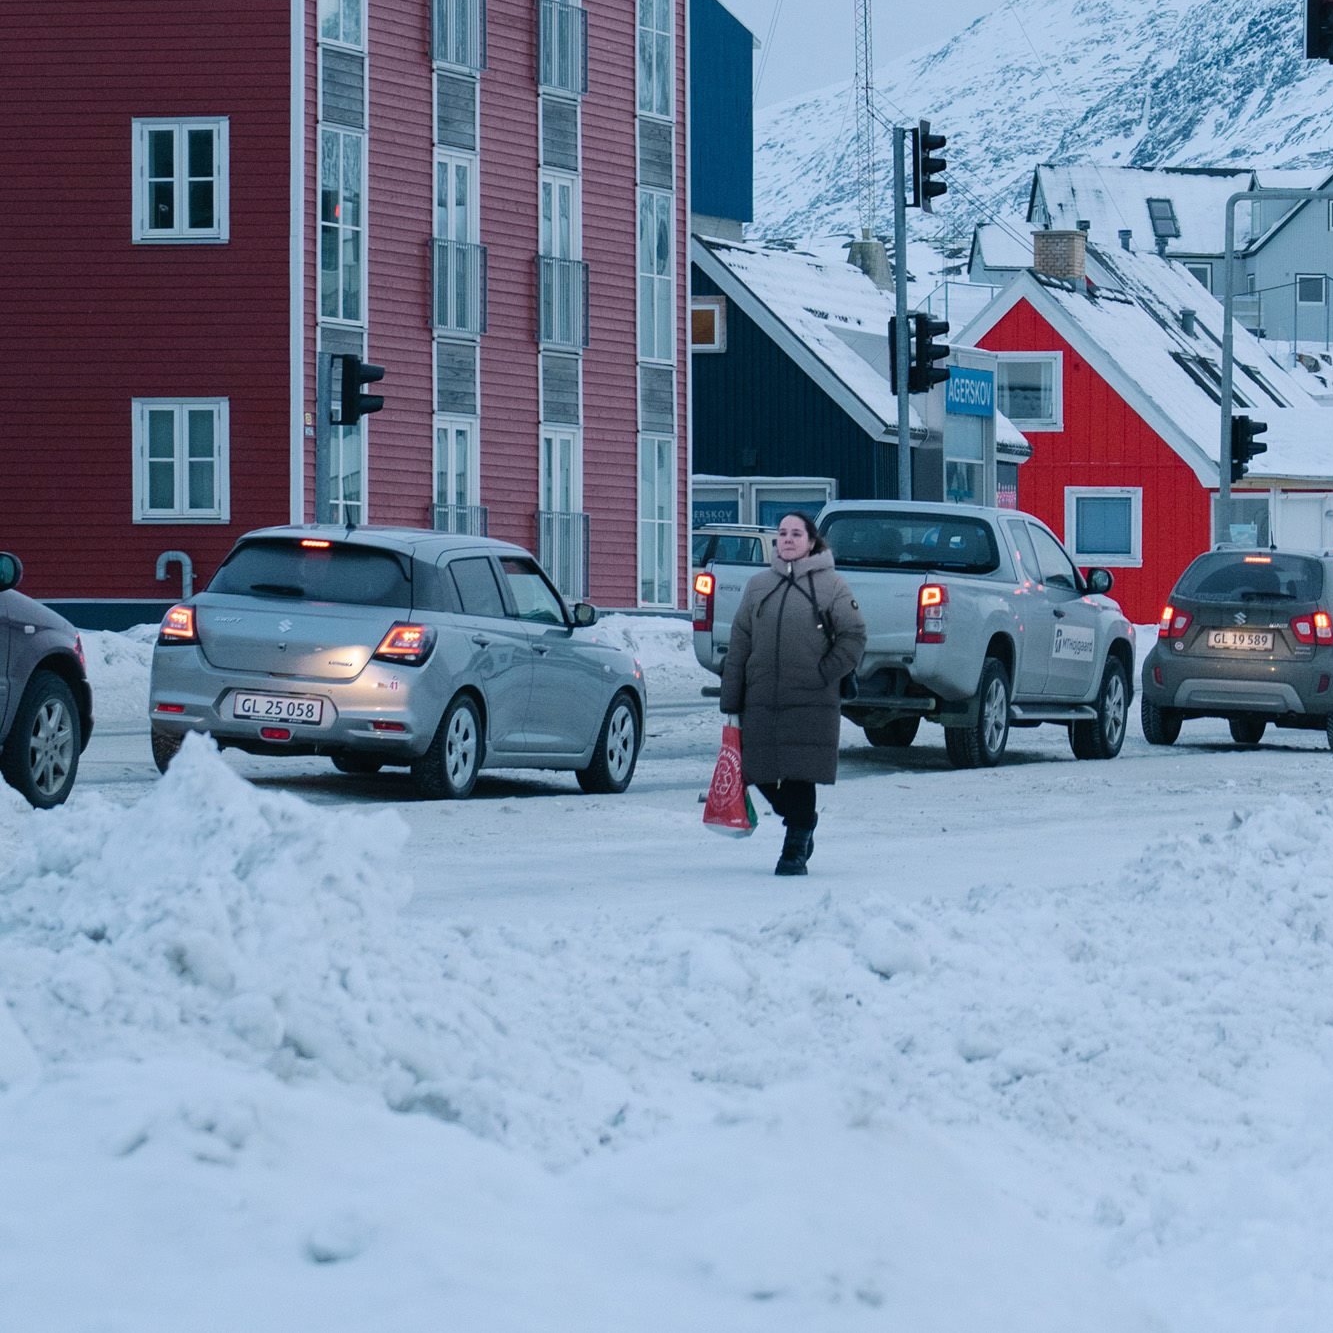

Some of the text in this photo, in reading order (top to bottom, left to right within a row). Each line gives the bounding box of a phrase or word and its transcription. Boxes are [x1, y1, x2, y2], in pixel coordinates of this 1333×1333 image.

[948, 377, 992, 406] AGERSKOV
[1213, 633, 1268, 646] GL 19 589
[389, 681, 398, 690] 41
[241, 698, 315, 718] GL 25 058
